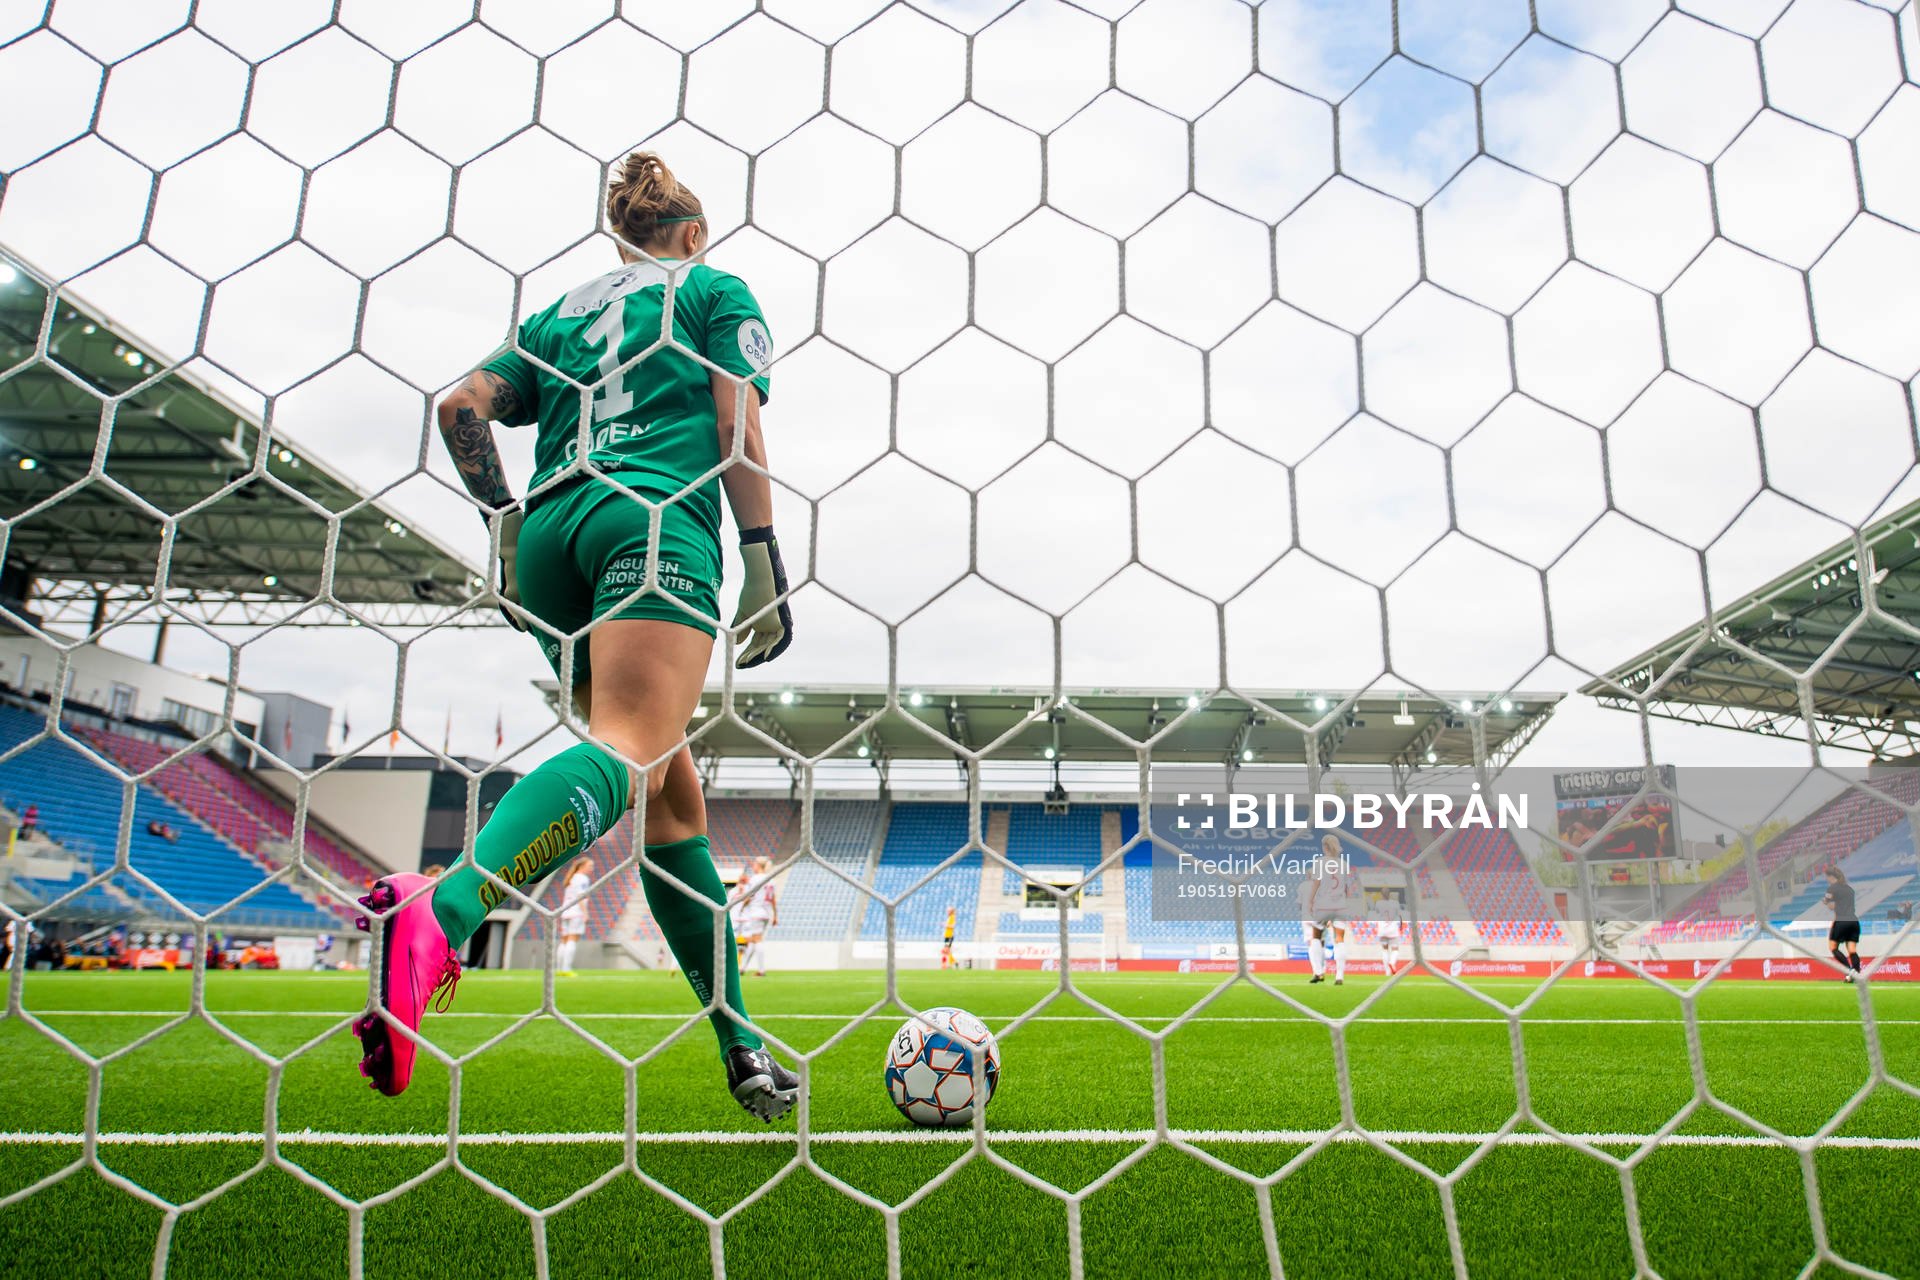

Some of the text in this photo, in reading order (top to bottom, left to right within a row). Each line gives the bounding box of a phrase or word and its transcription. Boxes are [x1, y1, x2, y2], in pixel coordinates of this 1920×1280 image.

[582, 296, 634, 423] 1
[745, 344, 768, 366] OBO
[607, 558, 680, 575] AGUEN
[604, 571, 695, 594] STORSNTER
[1265, 844, 1319, 852] smen
